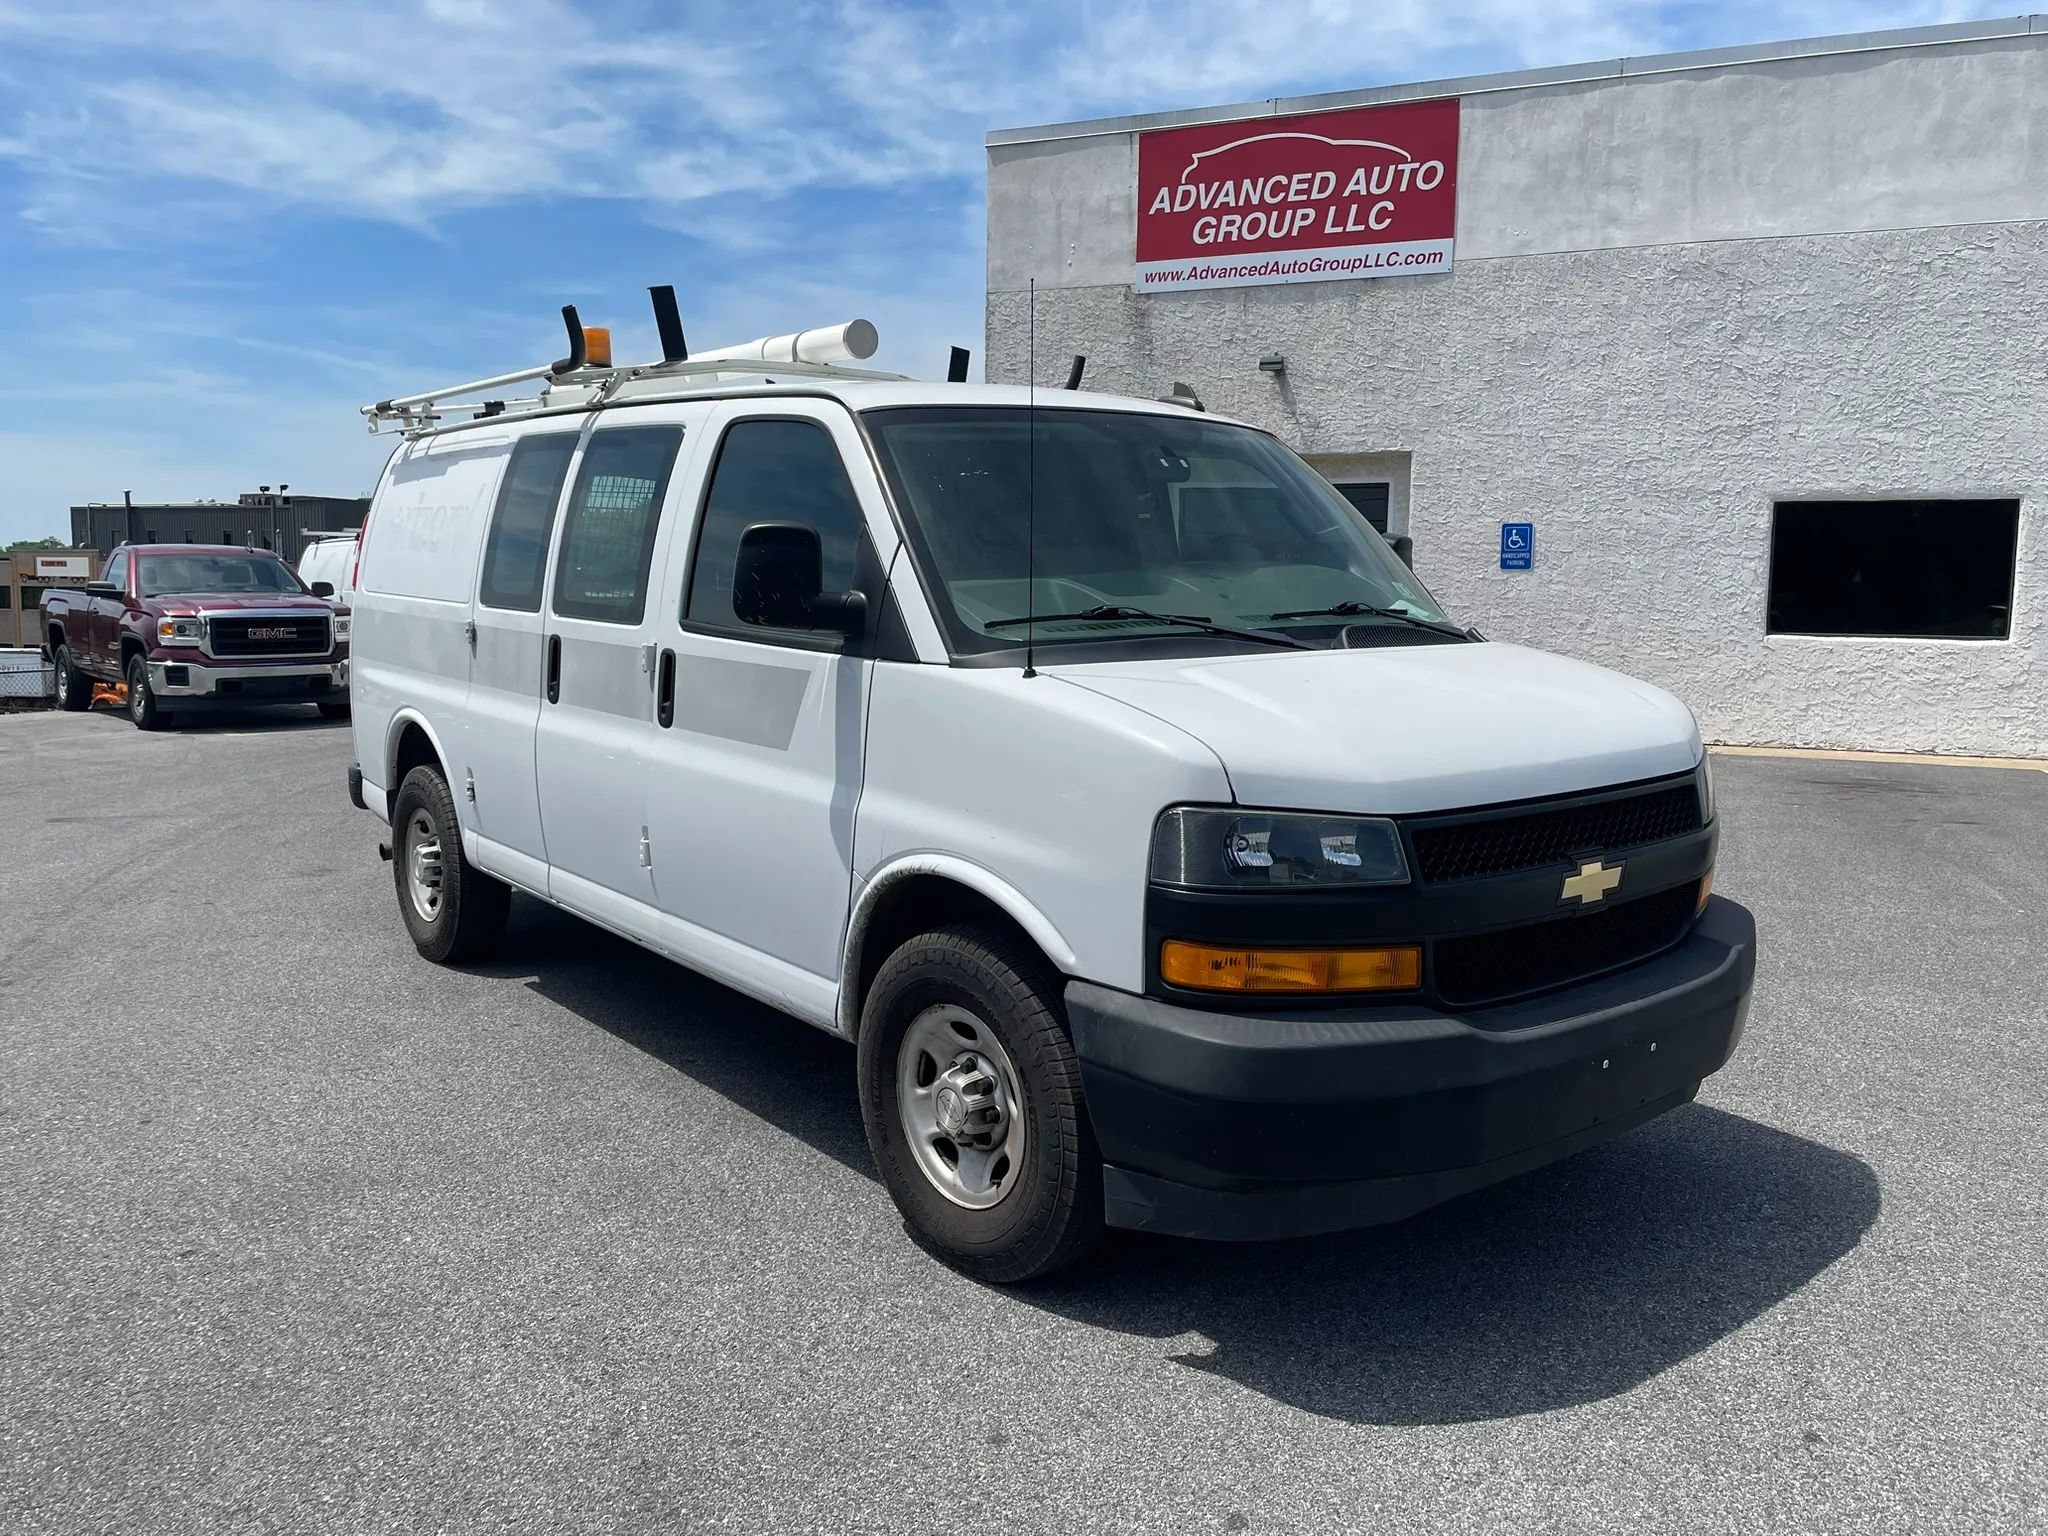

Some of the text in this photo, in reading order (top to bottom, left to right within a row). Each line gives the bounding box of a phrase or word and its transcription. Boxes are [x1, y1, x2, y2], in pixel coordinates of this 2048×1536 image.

[1149, 160, 1444, 215] ADVANCED AUTO
[1192, 201, 1394, 245] GROUP LLC
[1144, 251, 1443, 283] www.AdvancedAutoGroupLLC.com
[248, 628, 297, 639] GMC
